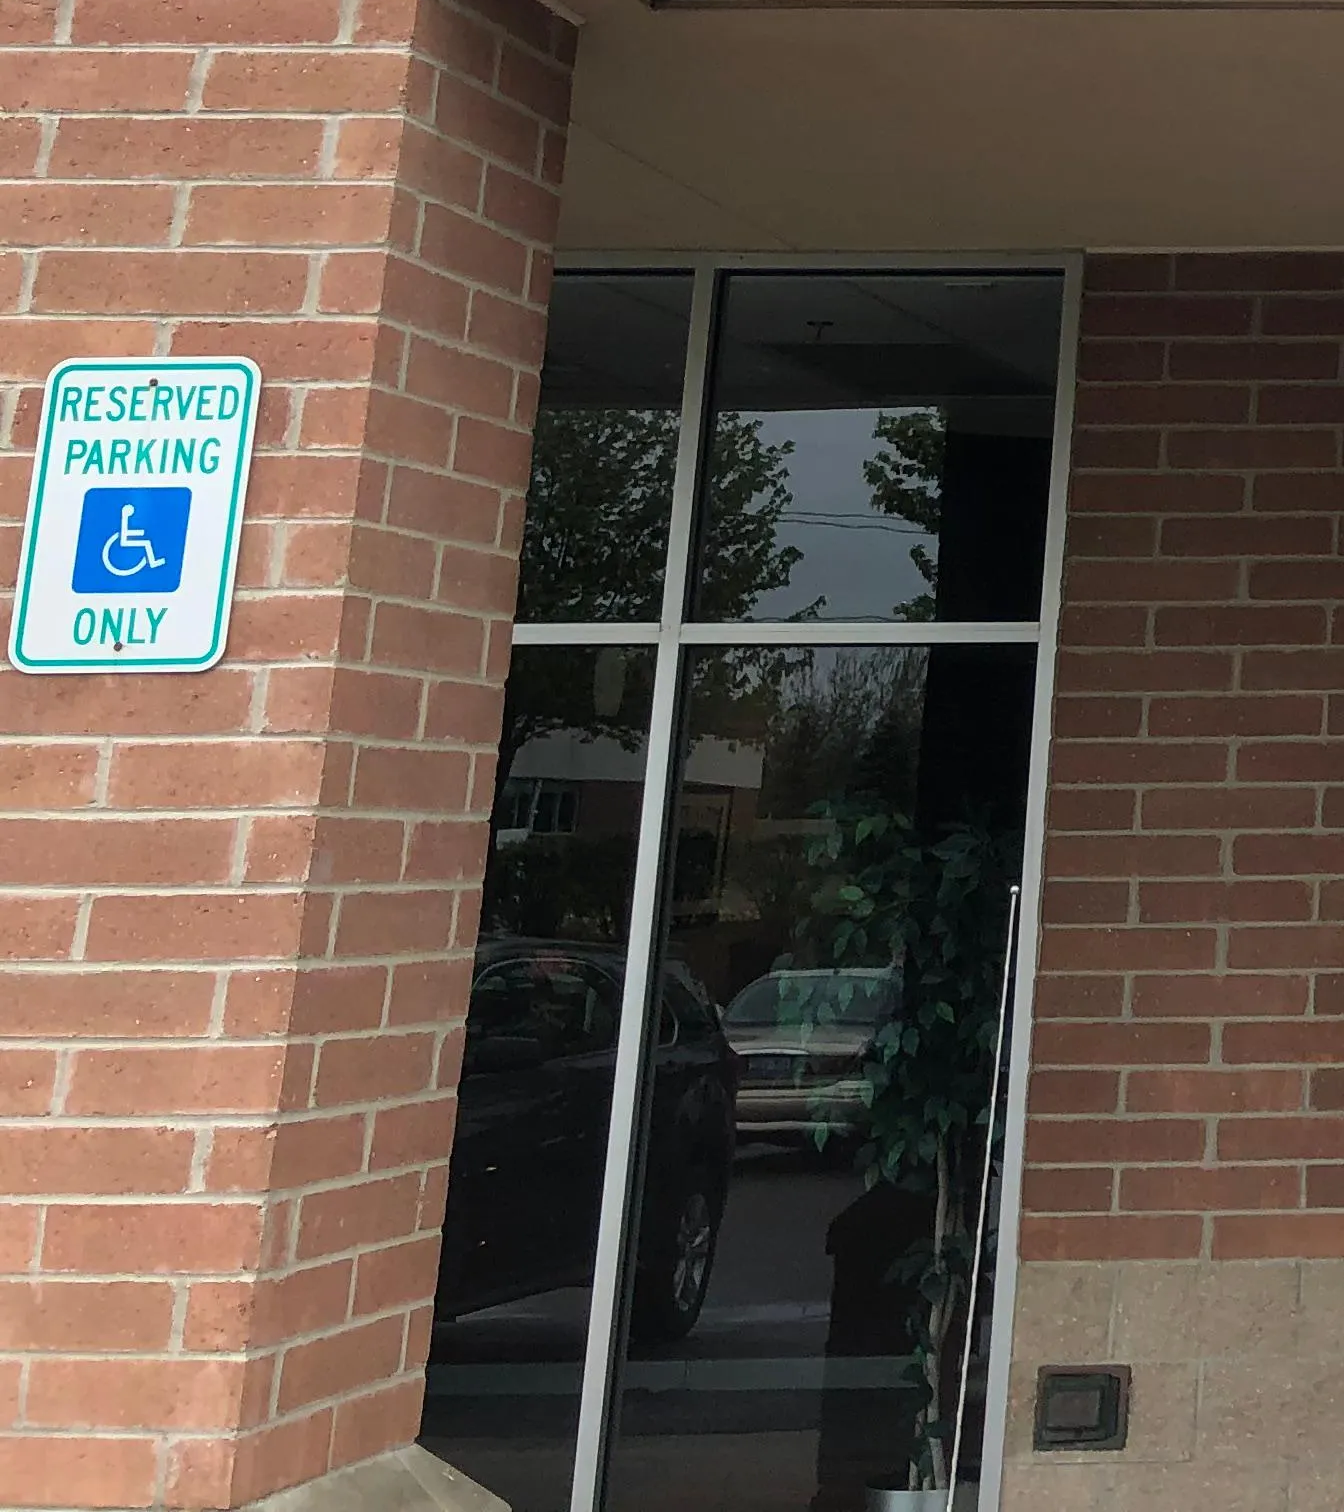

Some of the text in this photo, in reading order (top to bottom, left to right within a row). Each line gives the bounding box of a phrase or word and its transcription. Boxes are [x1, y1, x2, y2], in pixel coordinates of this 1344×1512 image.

[59, 385, 240, 423] RESERVED
[64, 438, 222, 475] PARKING
[73, 607, 169, 646] ONLY
